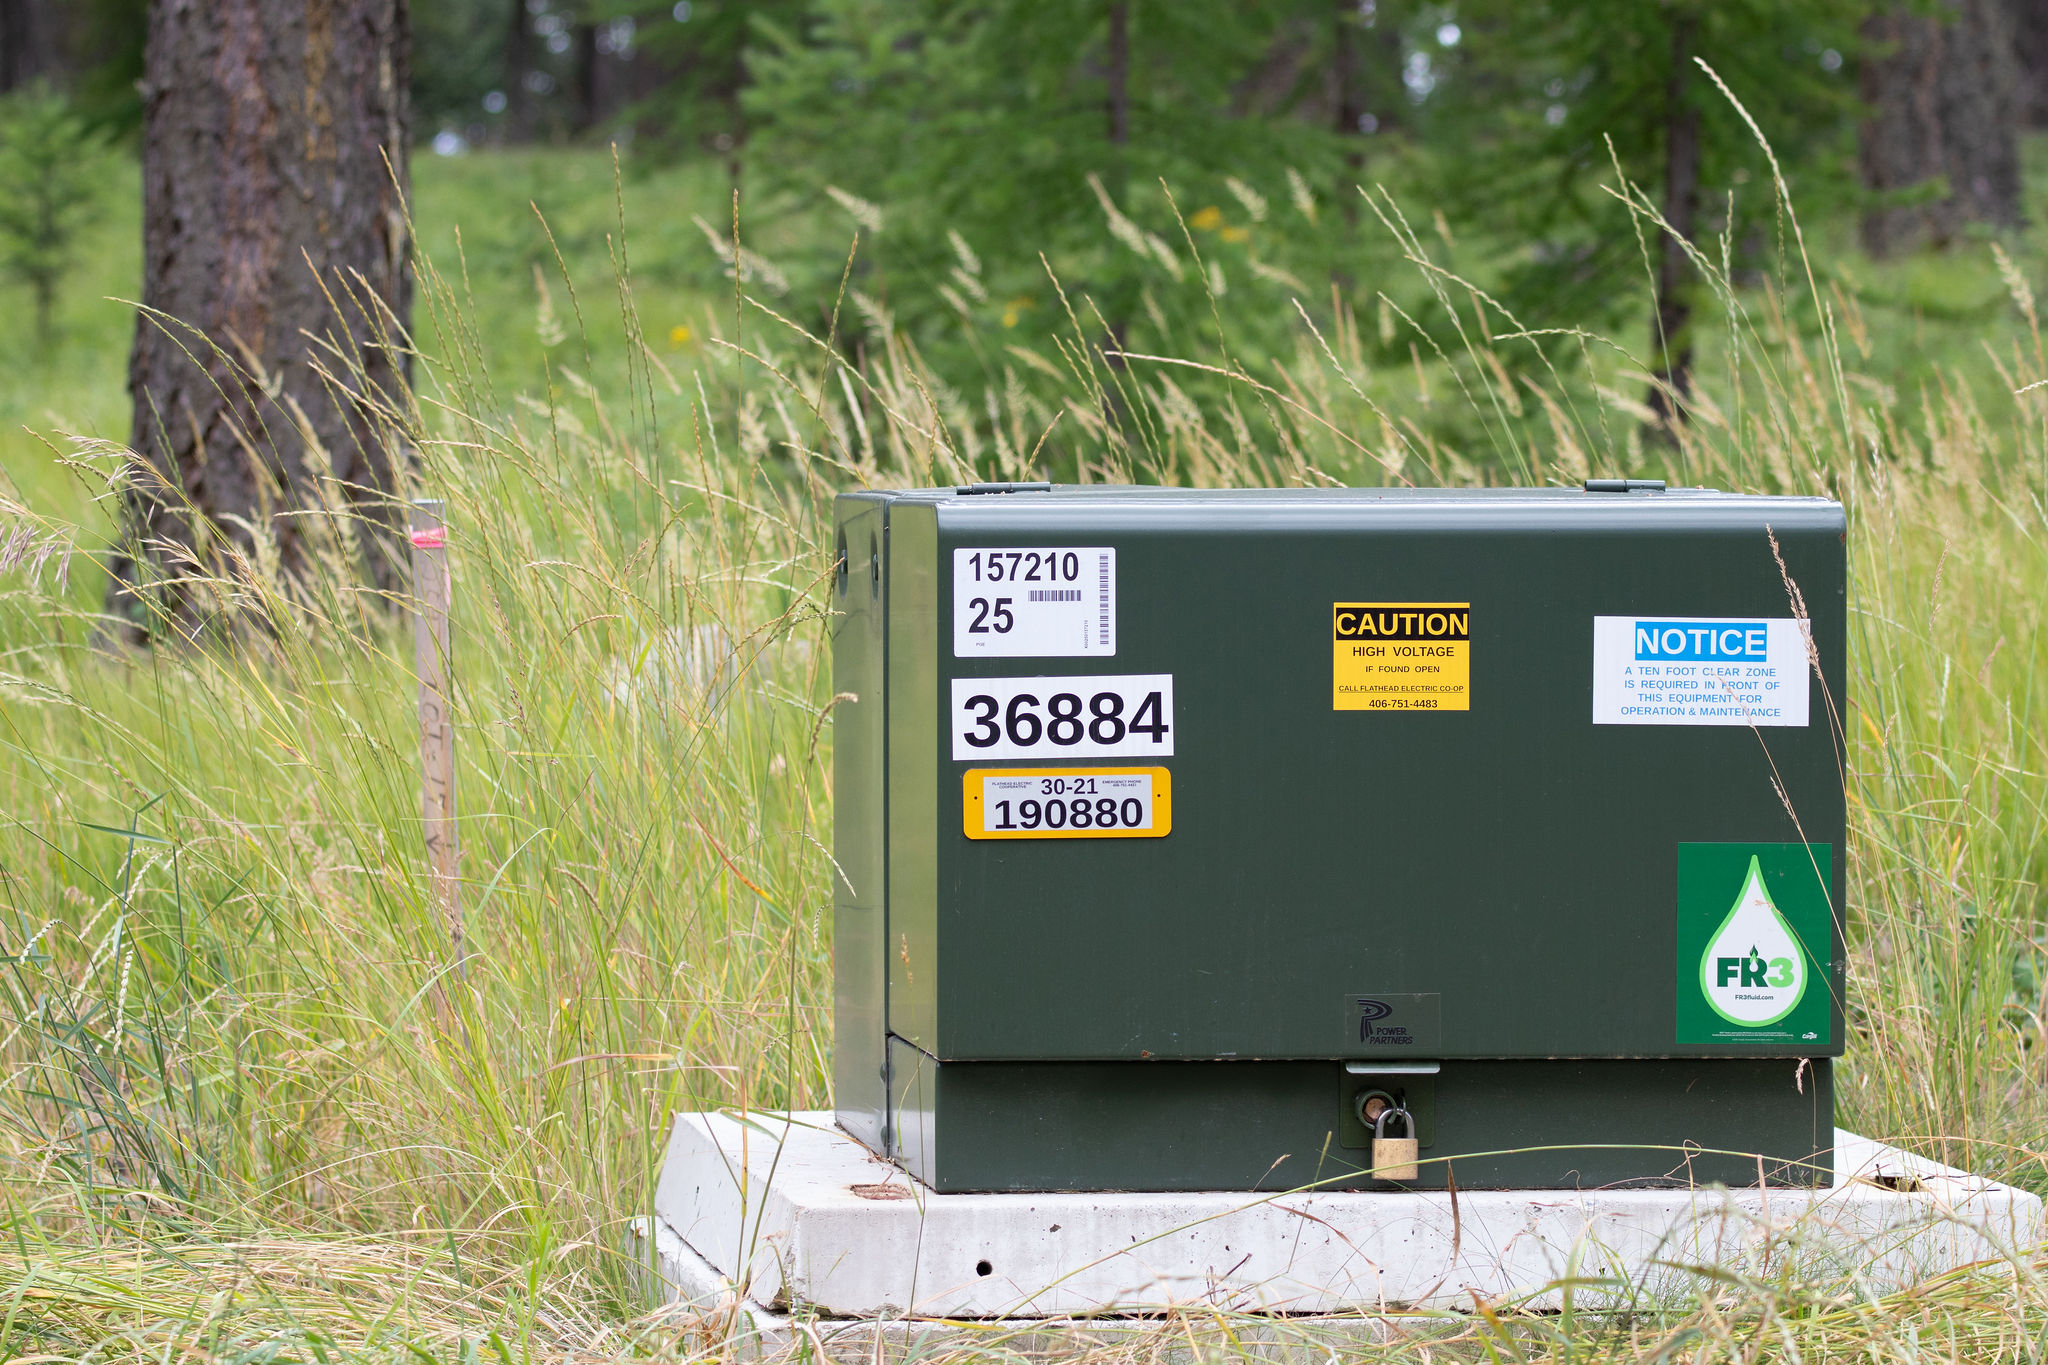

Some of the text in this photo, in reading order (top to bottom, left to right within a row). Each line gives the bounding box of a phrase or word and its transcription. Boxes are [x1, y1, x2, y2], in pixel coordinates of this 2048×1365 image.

[969, 552, 1079, 582] 157210
[968, 597, 1014, 634] 25
[1336, 613, 1468, 636] CAUTION
[1636, 628, 1766, 656] NOTICE
[1352, 646, 1455, 657] HIGH VOLTAGE
[1365, 665, 1440, 673] IF FOUND OPEN
[1624, 666, 1777, 677] A TEN FOOT CLEAR ZONE
[1624, 680, 1781, 690] IS REQUIRED IN FRONT OF
[1368, 699, 1438, 708] 406-751-4483
[1637, 693, 1762, 704] THIS EQUIPMENT FOR
[1620, 706, 1686, 716] OPERATION
[1688, 707, 1697, 716] &
[963, 691, 1169, 748] 36884
[1041, 777, 1099, 795] 30-21
[995, 797, 1143, 830] 190880
[1717, 957, 1795, 988] FR3
[1376, 1027, 1407, 1036] POWER
[1369, 1036, 1413, 1045] PARTNERS
